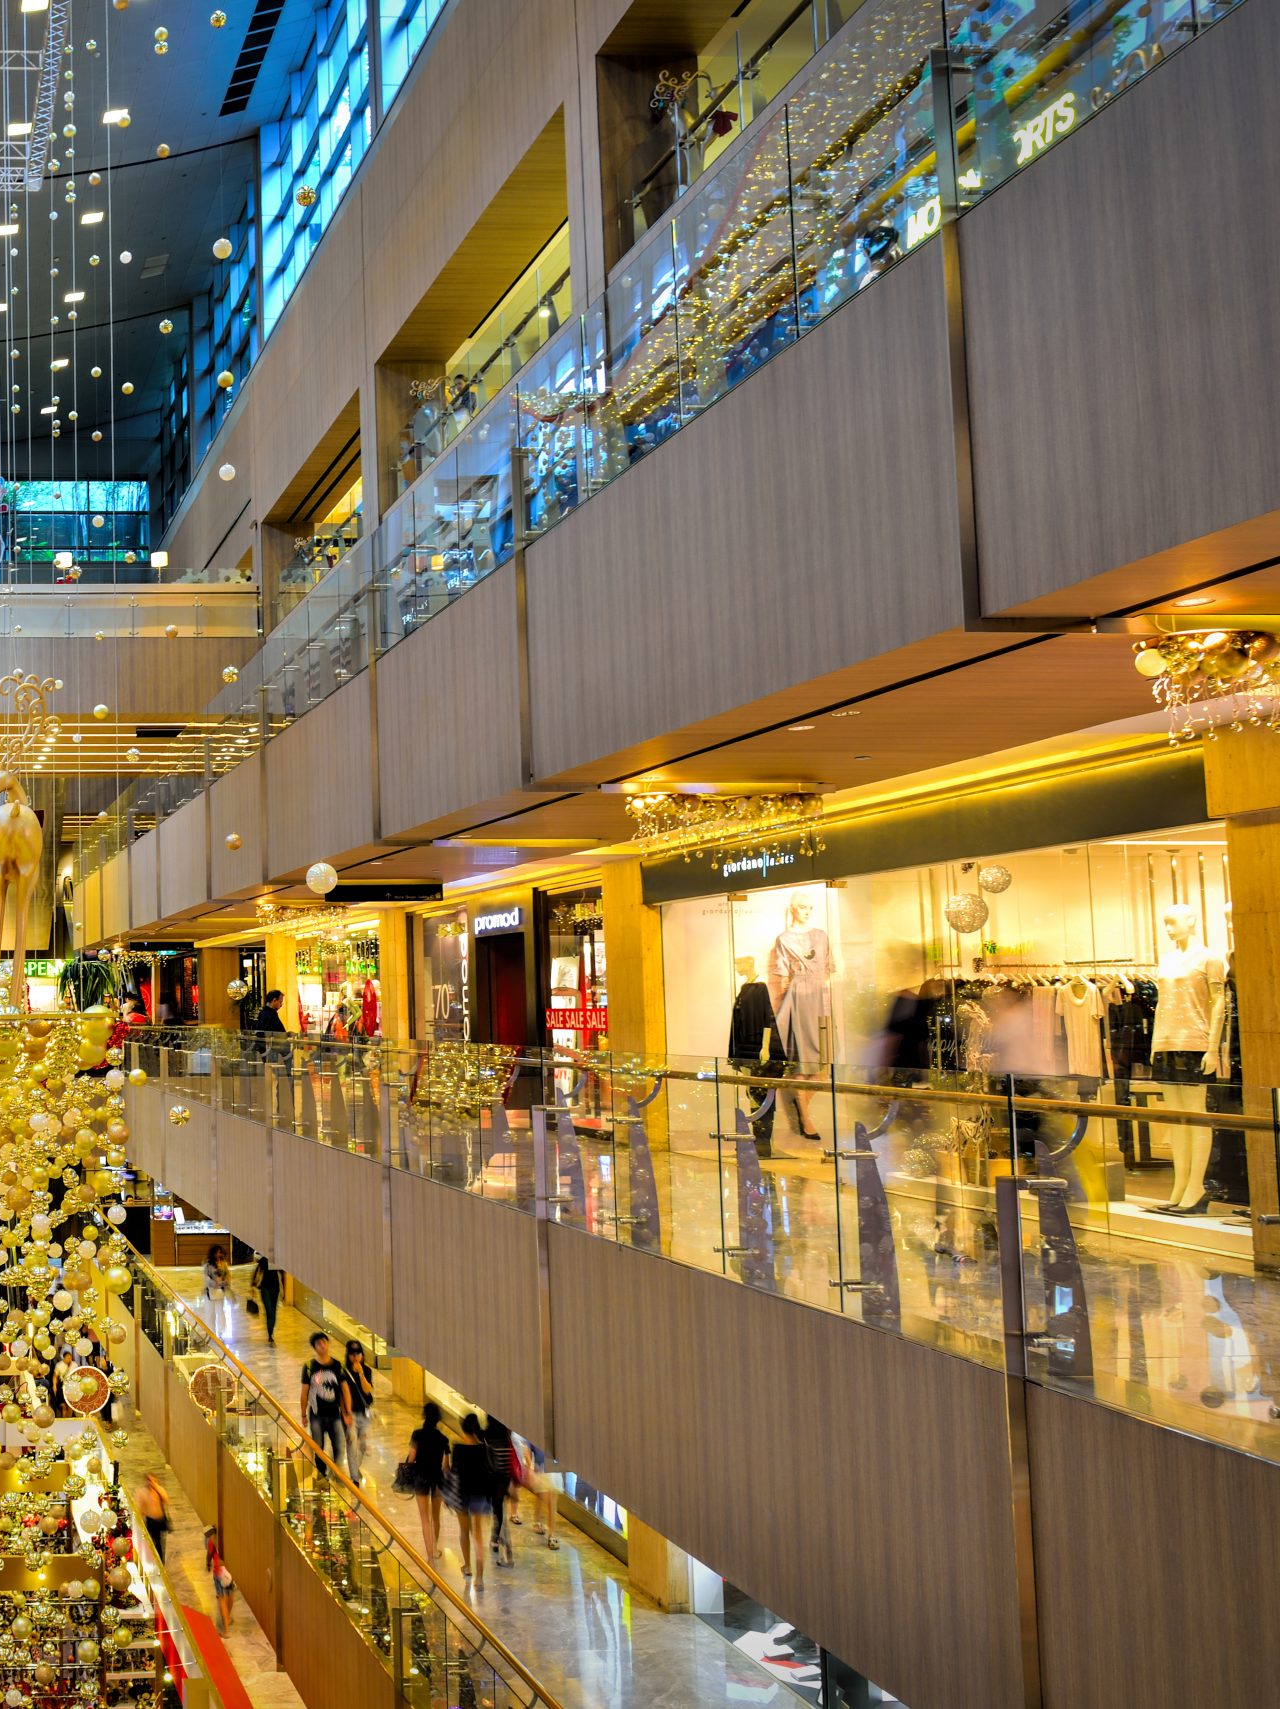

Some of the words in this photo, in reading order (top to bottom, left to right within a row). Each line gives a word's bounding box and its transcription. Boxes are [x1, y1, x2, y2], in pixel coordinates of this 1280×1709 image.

[723, 856, 764, 878] giordano
[474, 906, 521, 935] promod
[545, 1010, 564, 1029] SALE
[565, 1010, 585, 1029] SALE
[585, 1011, 606, 1029] SALE
